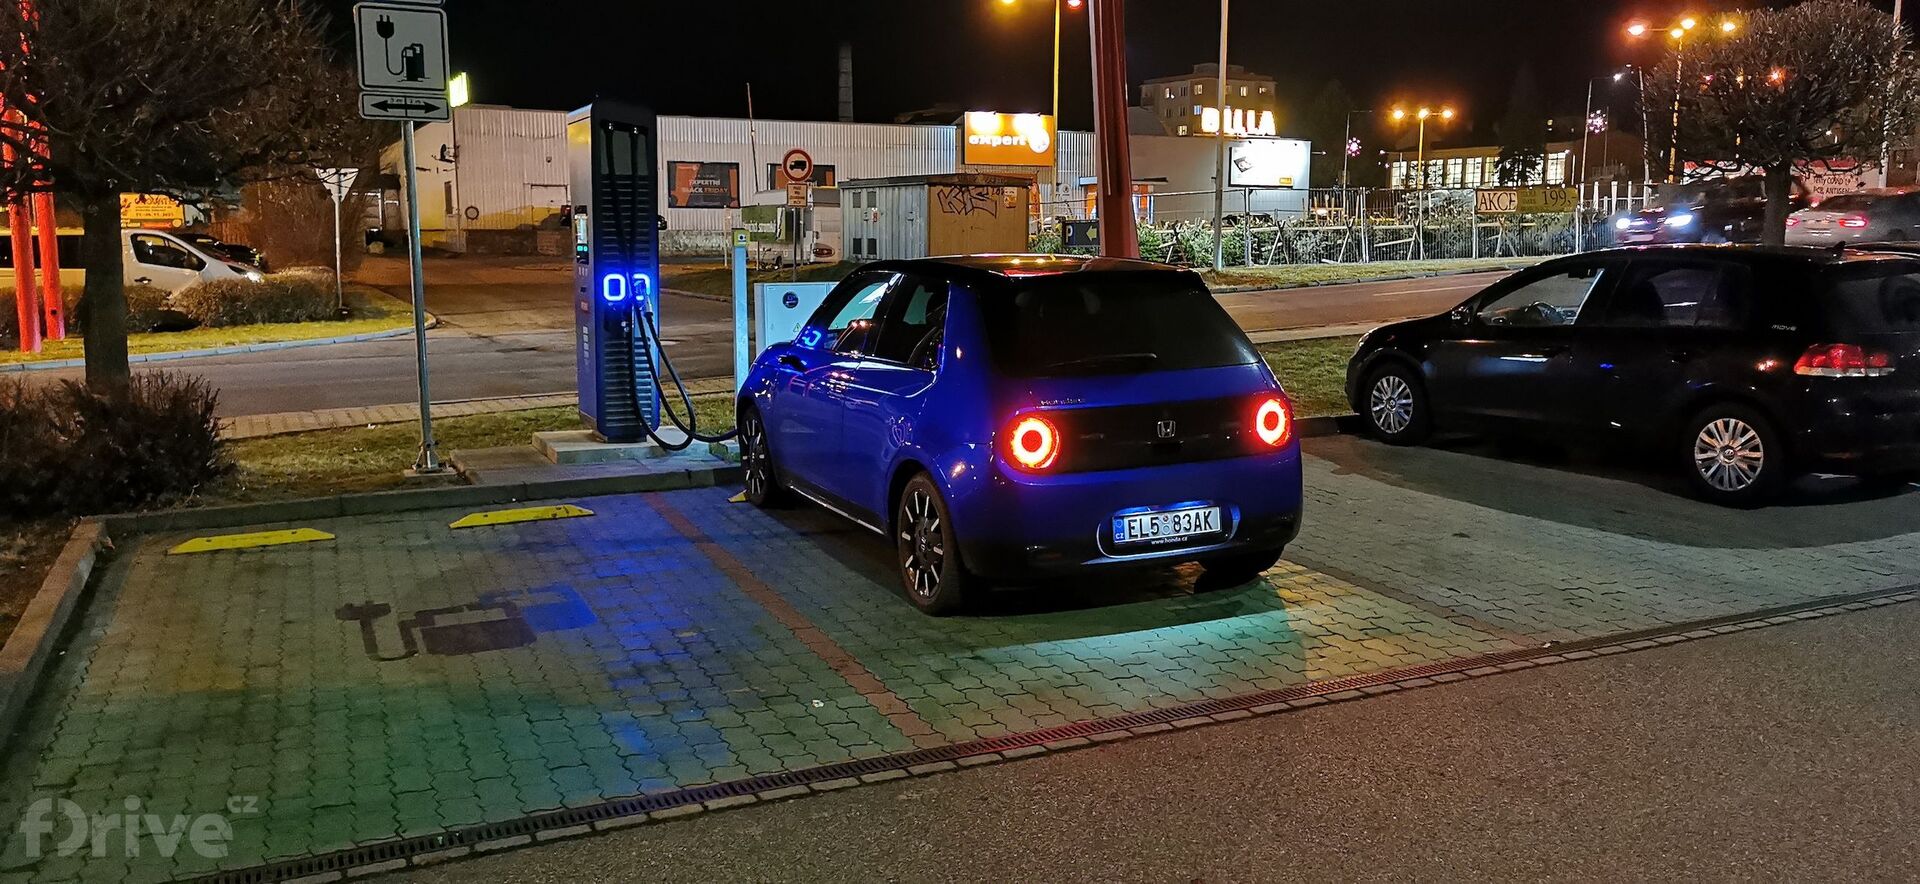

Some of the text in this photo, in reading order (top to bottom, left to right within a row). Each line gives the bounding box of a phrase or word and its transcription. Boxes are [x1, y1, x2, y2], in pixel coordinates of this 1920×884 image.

[968, 134, 1026, 147] expert
[1478, 192, 1517, 211] AKCE
[1066, 225, 1074, 243] P
[1128, 517, 1160, 540] EL5
[1173, 510, 1213, 534] 83AK
[1150, 536, 1188, 545] www.honda.cz
